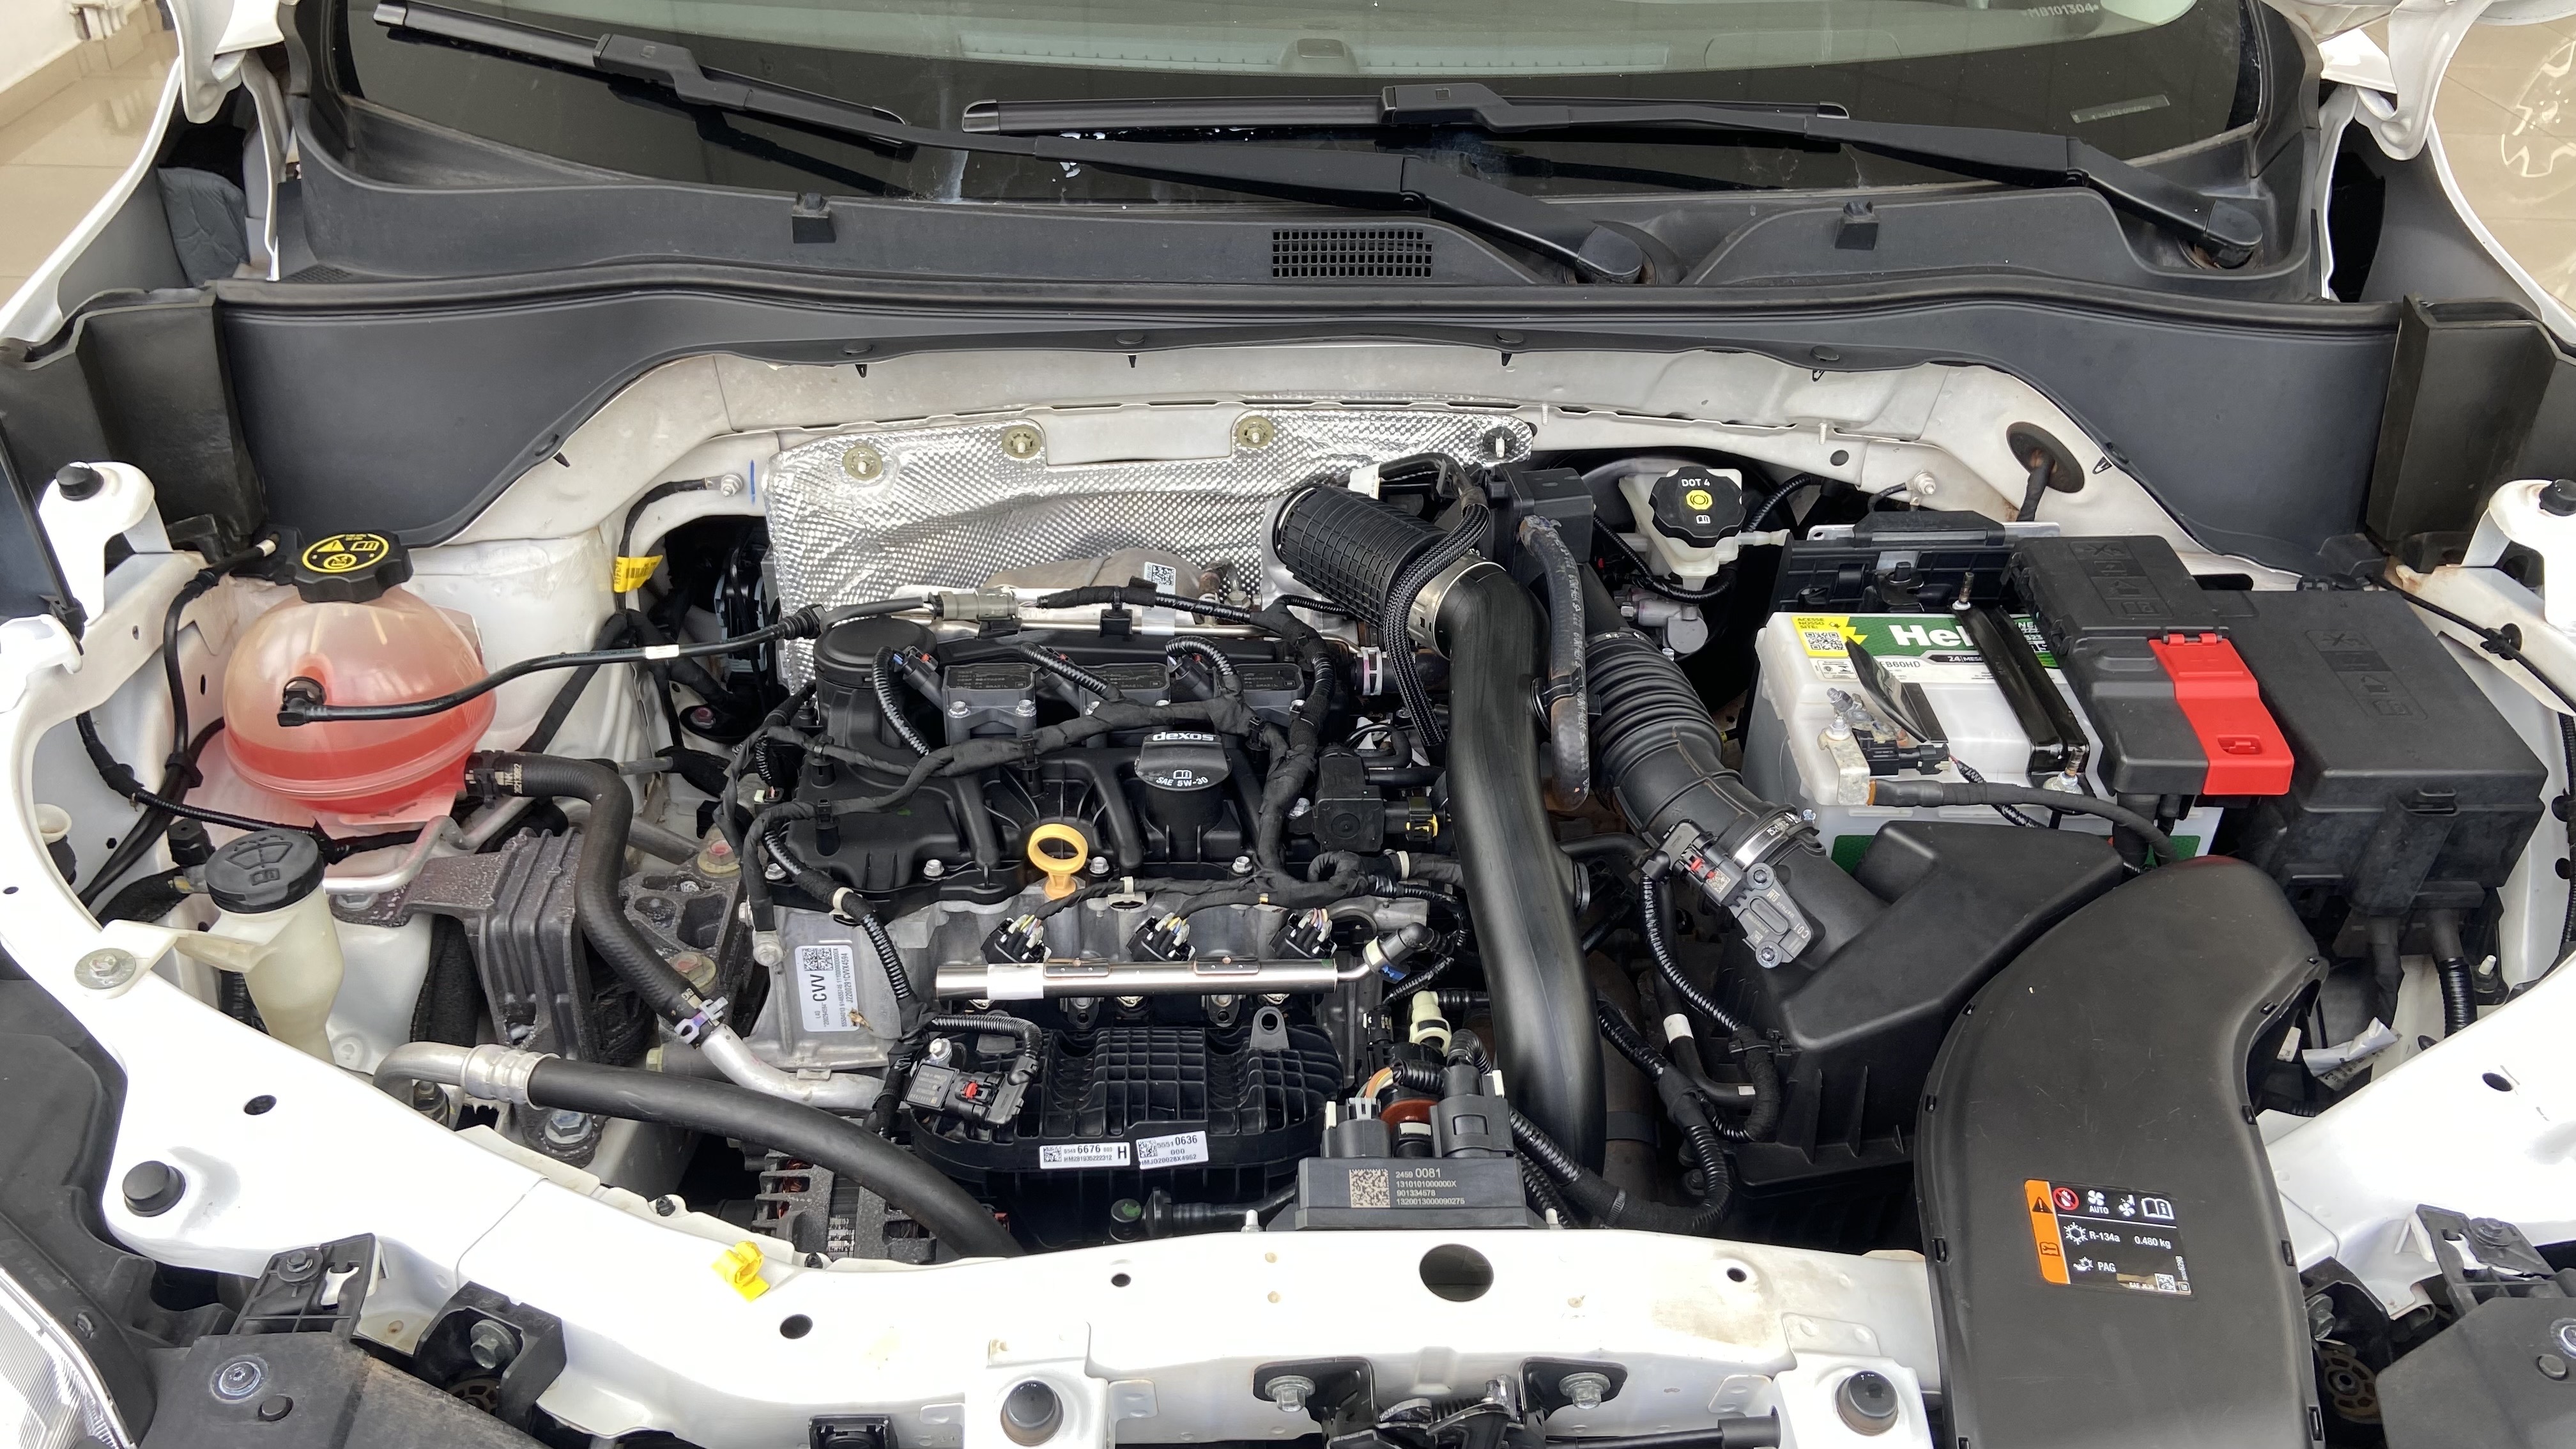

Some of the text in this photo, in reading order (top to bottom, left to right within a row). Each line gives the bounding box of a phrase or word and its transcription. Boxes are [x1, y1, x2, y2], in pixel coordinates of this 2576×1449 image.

[1681, 479, 1711, 487] DOT 4
[1153, 732, 1215, 741] dexos
[1156, 776, 1209, 786] SAE 5W-30
[1767, 889, 1781, 902] GM
[809, 974, 827, 1002] CVV
[1175, 1135, 1197, 1146] 0636
[1077, 1144, 1101, 1154] 6676
[1117, 1146, 1126, 1159] H
[1395, 1167, 1442, 1179] 2459 0081
[2089, 1205, 2109, 1215] AUTO
[2089, 1230, 2172, 1249] R-134a 0.480 kg
[2097, 1261, 2117, 1273] PAG
